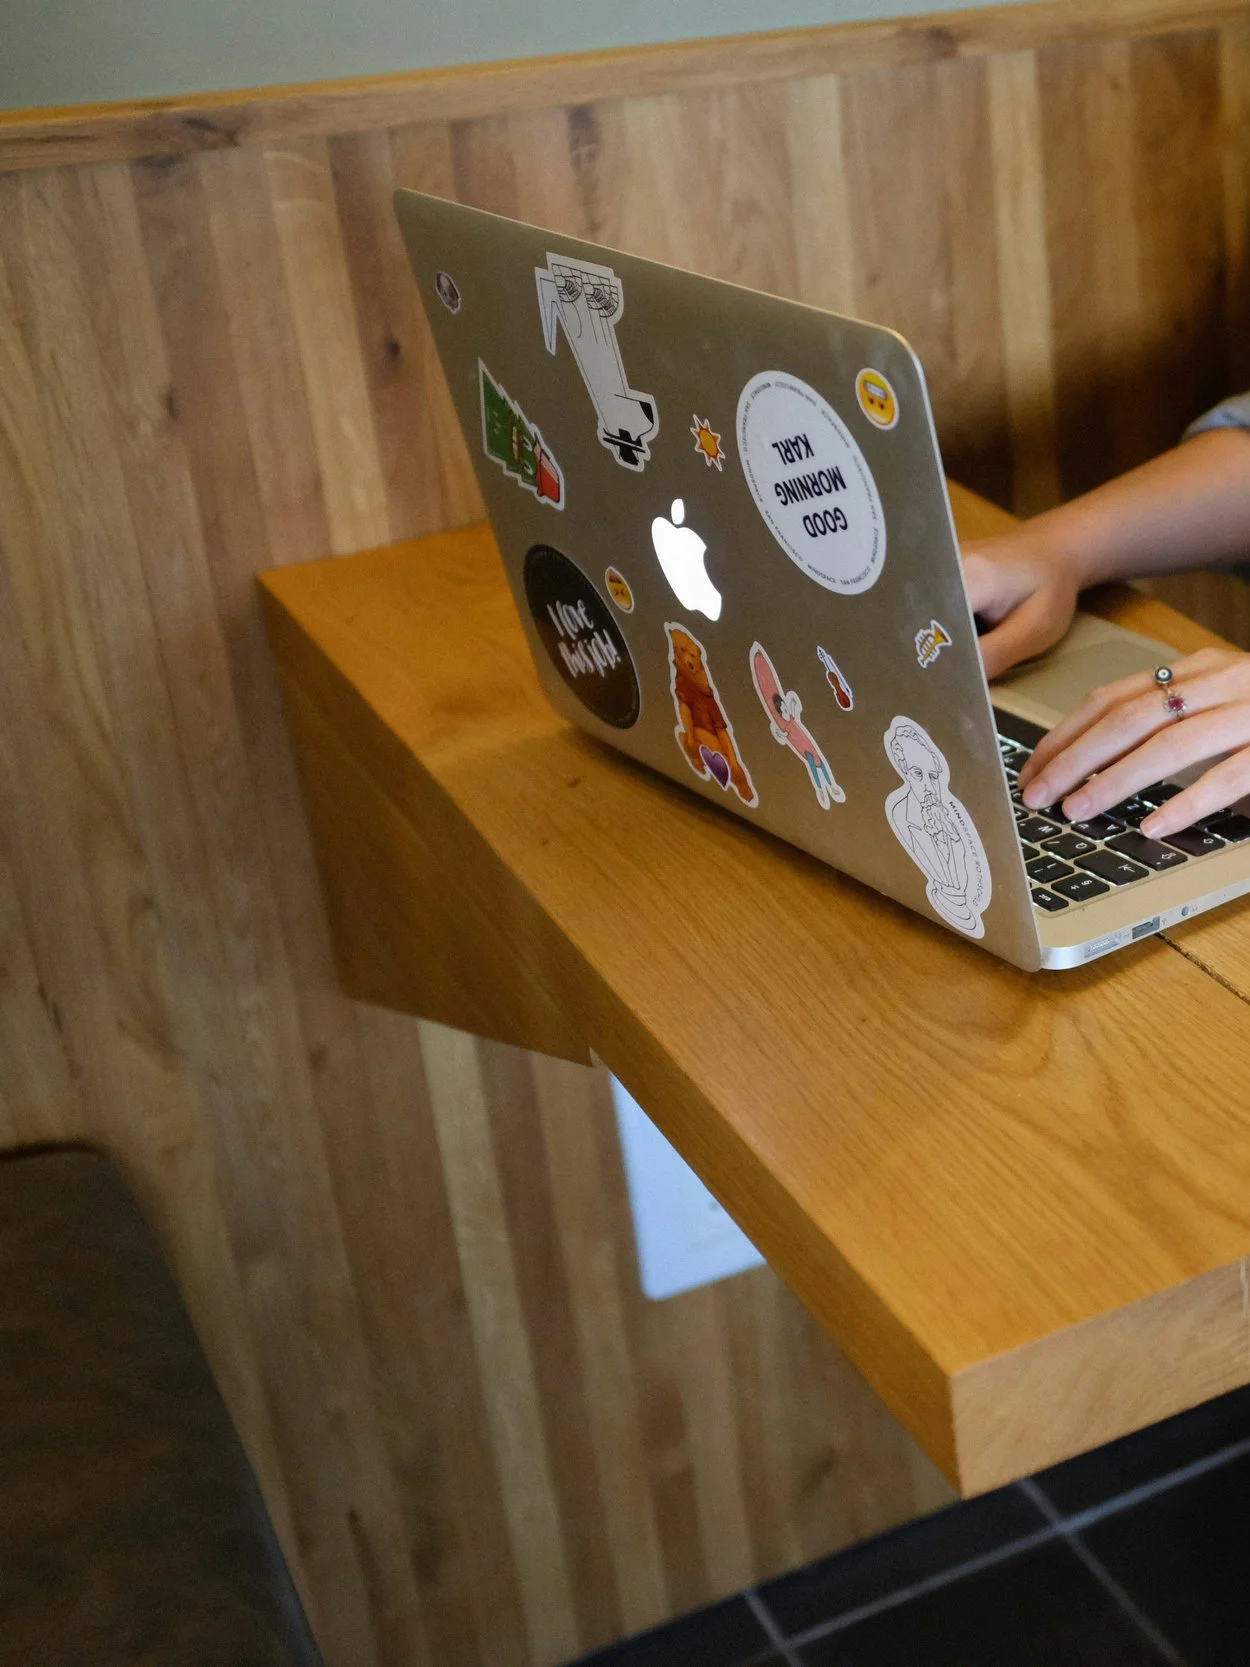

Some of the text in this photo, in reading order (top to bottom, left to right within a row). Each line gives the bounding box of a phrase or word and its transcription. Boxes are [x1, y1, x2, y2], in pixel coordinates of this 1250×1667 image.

[771, 433, 815, 466] KARL
[774, 466, 847, 507] MORNING
[802, 507, 848, 538] GOOD
[546, 599, 594, 641] I love
[949, 801, 979, 858] MINDSPACE
[1038, 825, 1054, 834] W
[1075, 841, 1088, 850] Q
